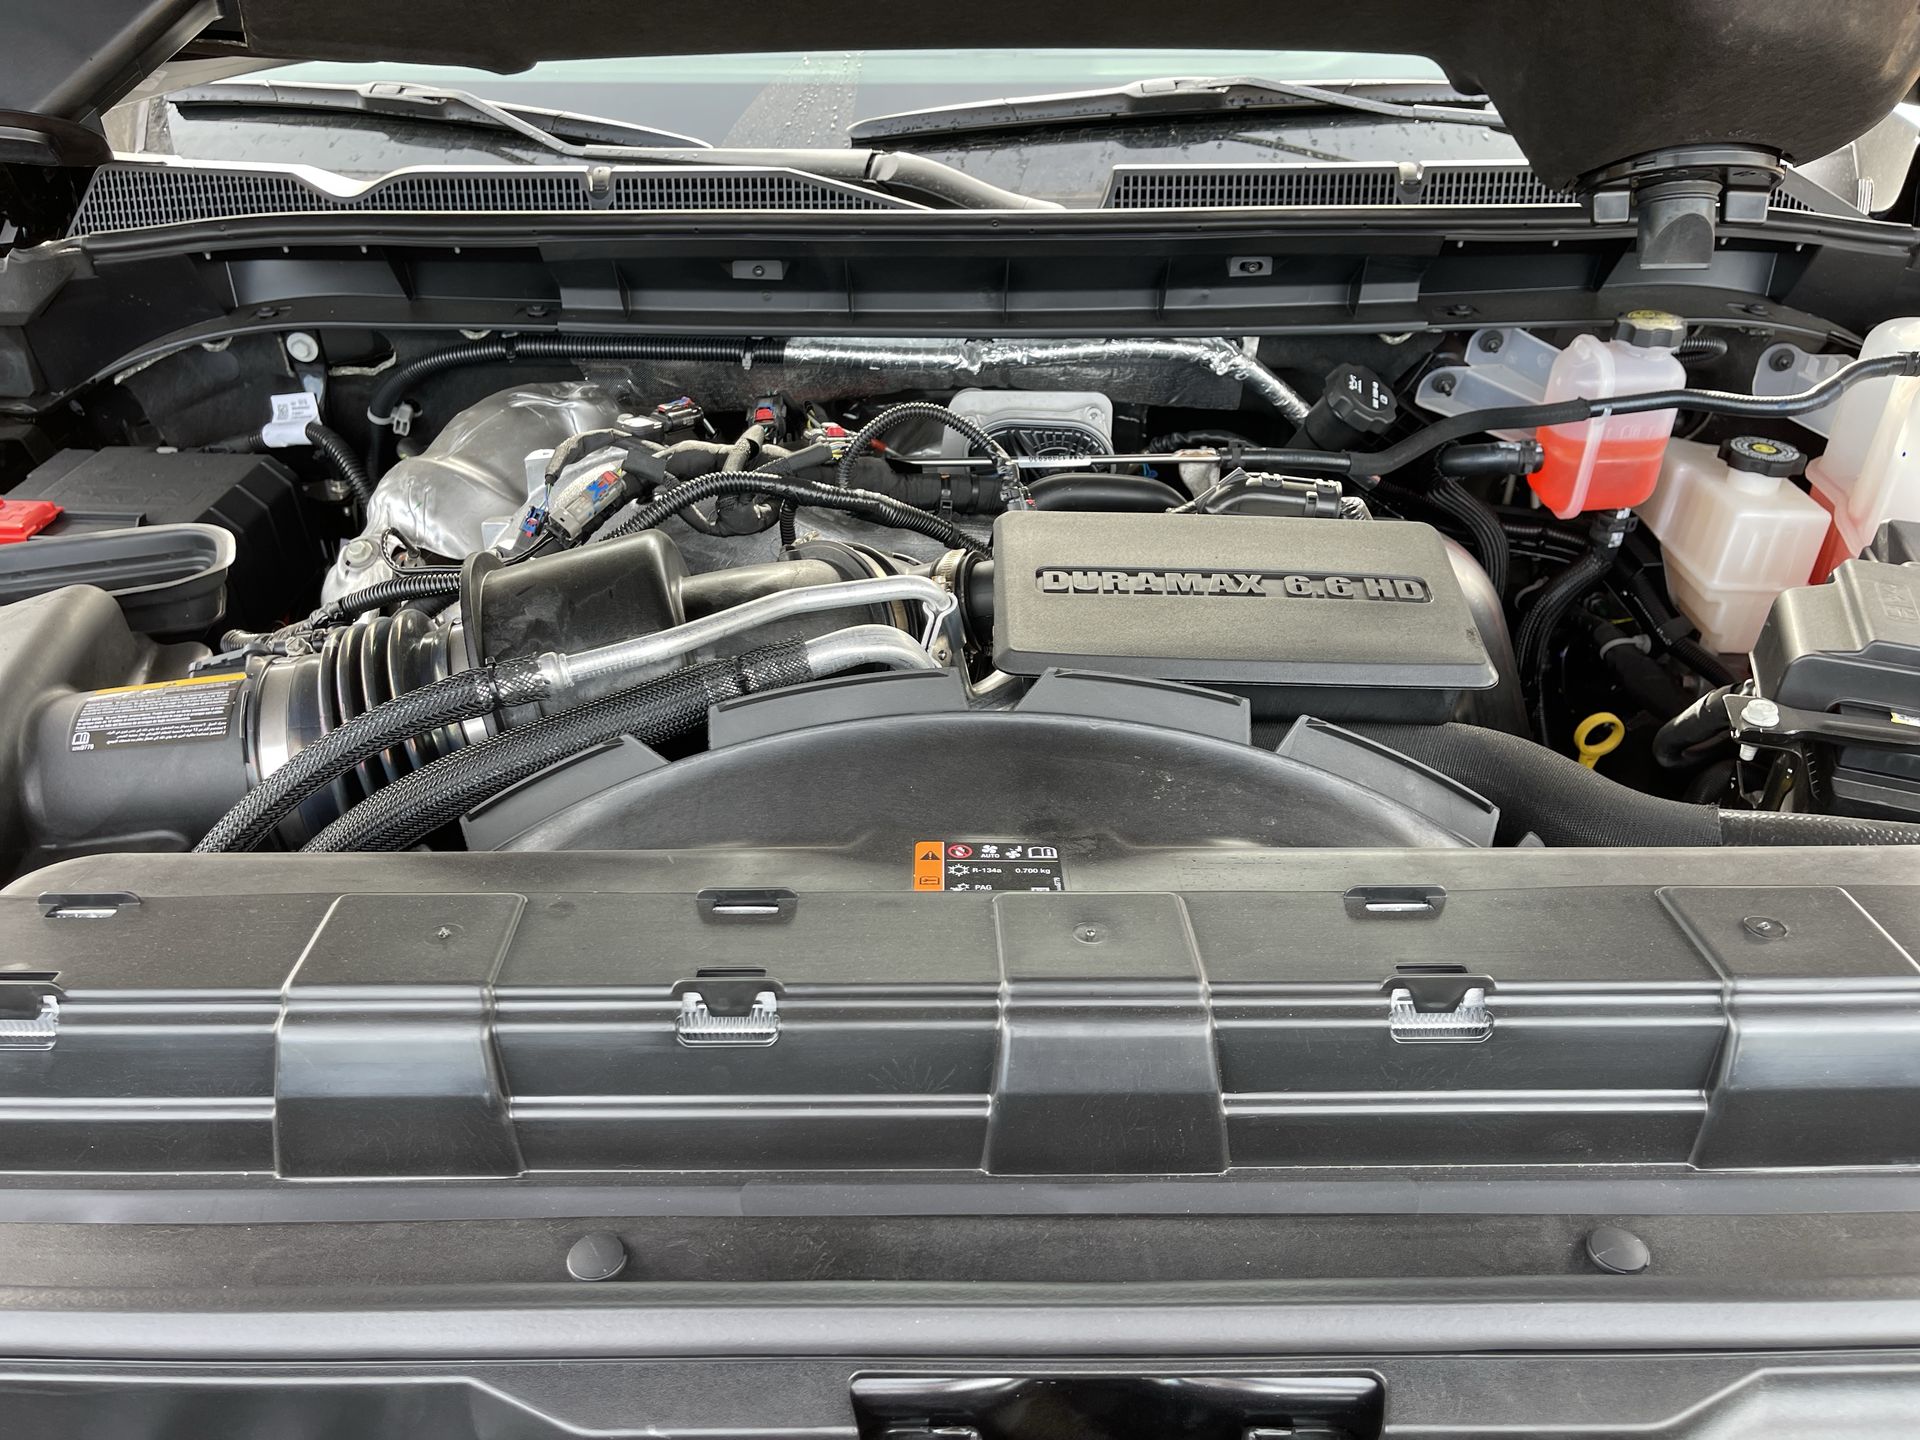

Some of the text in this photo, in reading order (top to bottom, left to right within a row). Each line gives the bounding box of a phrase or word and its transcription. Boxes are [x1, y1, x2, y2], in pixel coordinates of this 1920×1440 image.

[1042, 570, 1425, 600] DURAMAX 6.6 HD
[1039, 867, 1051, 875] kg
